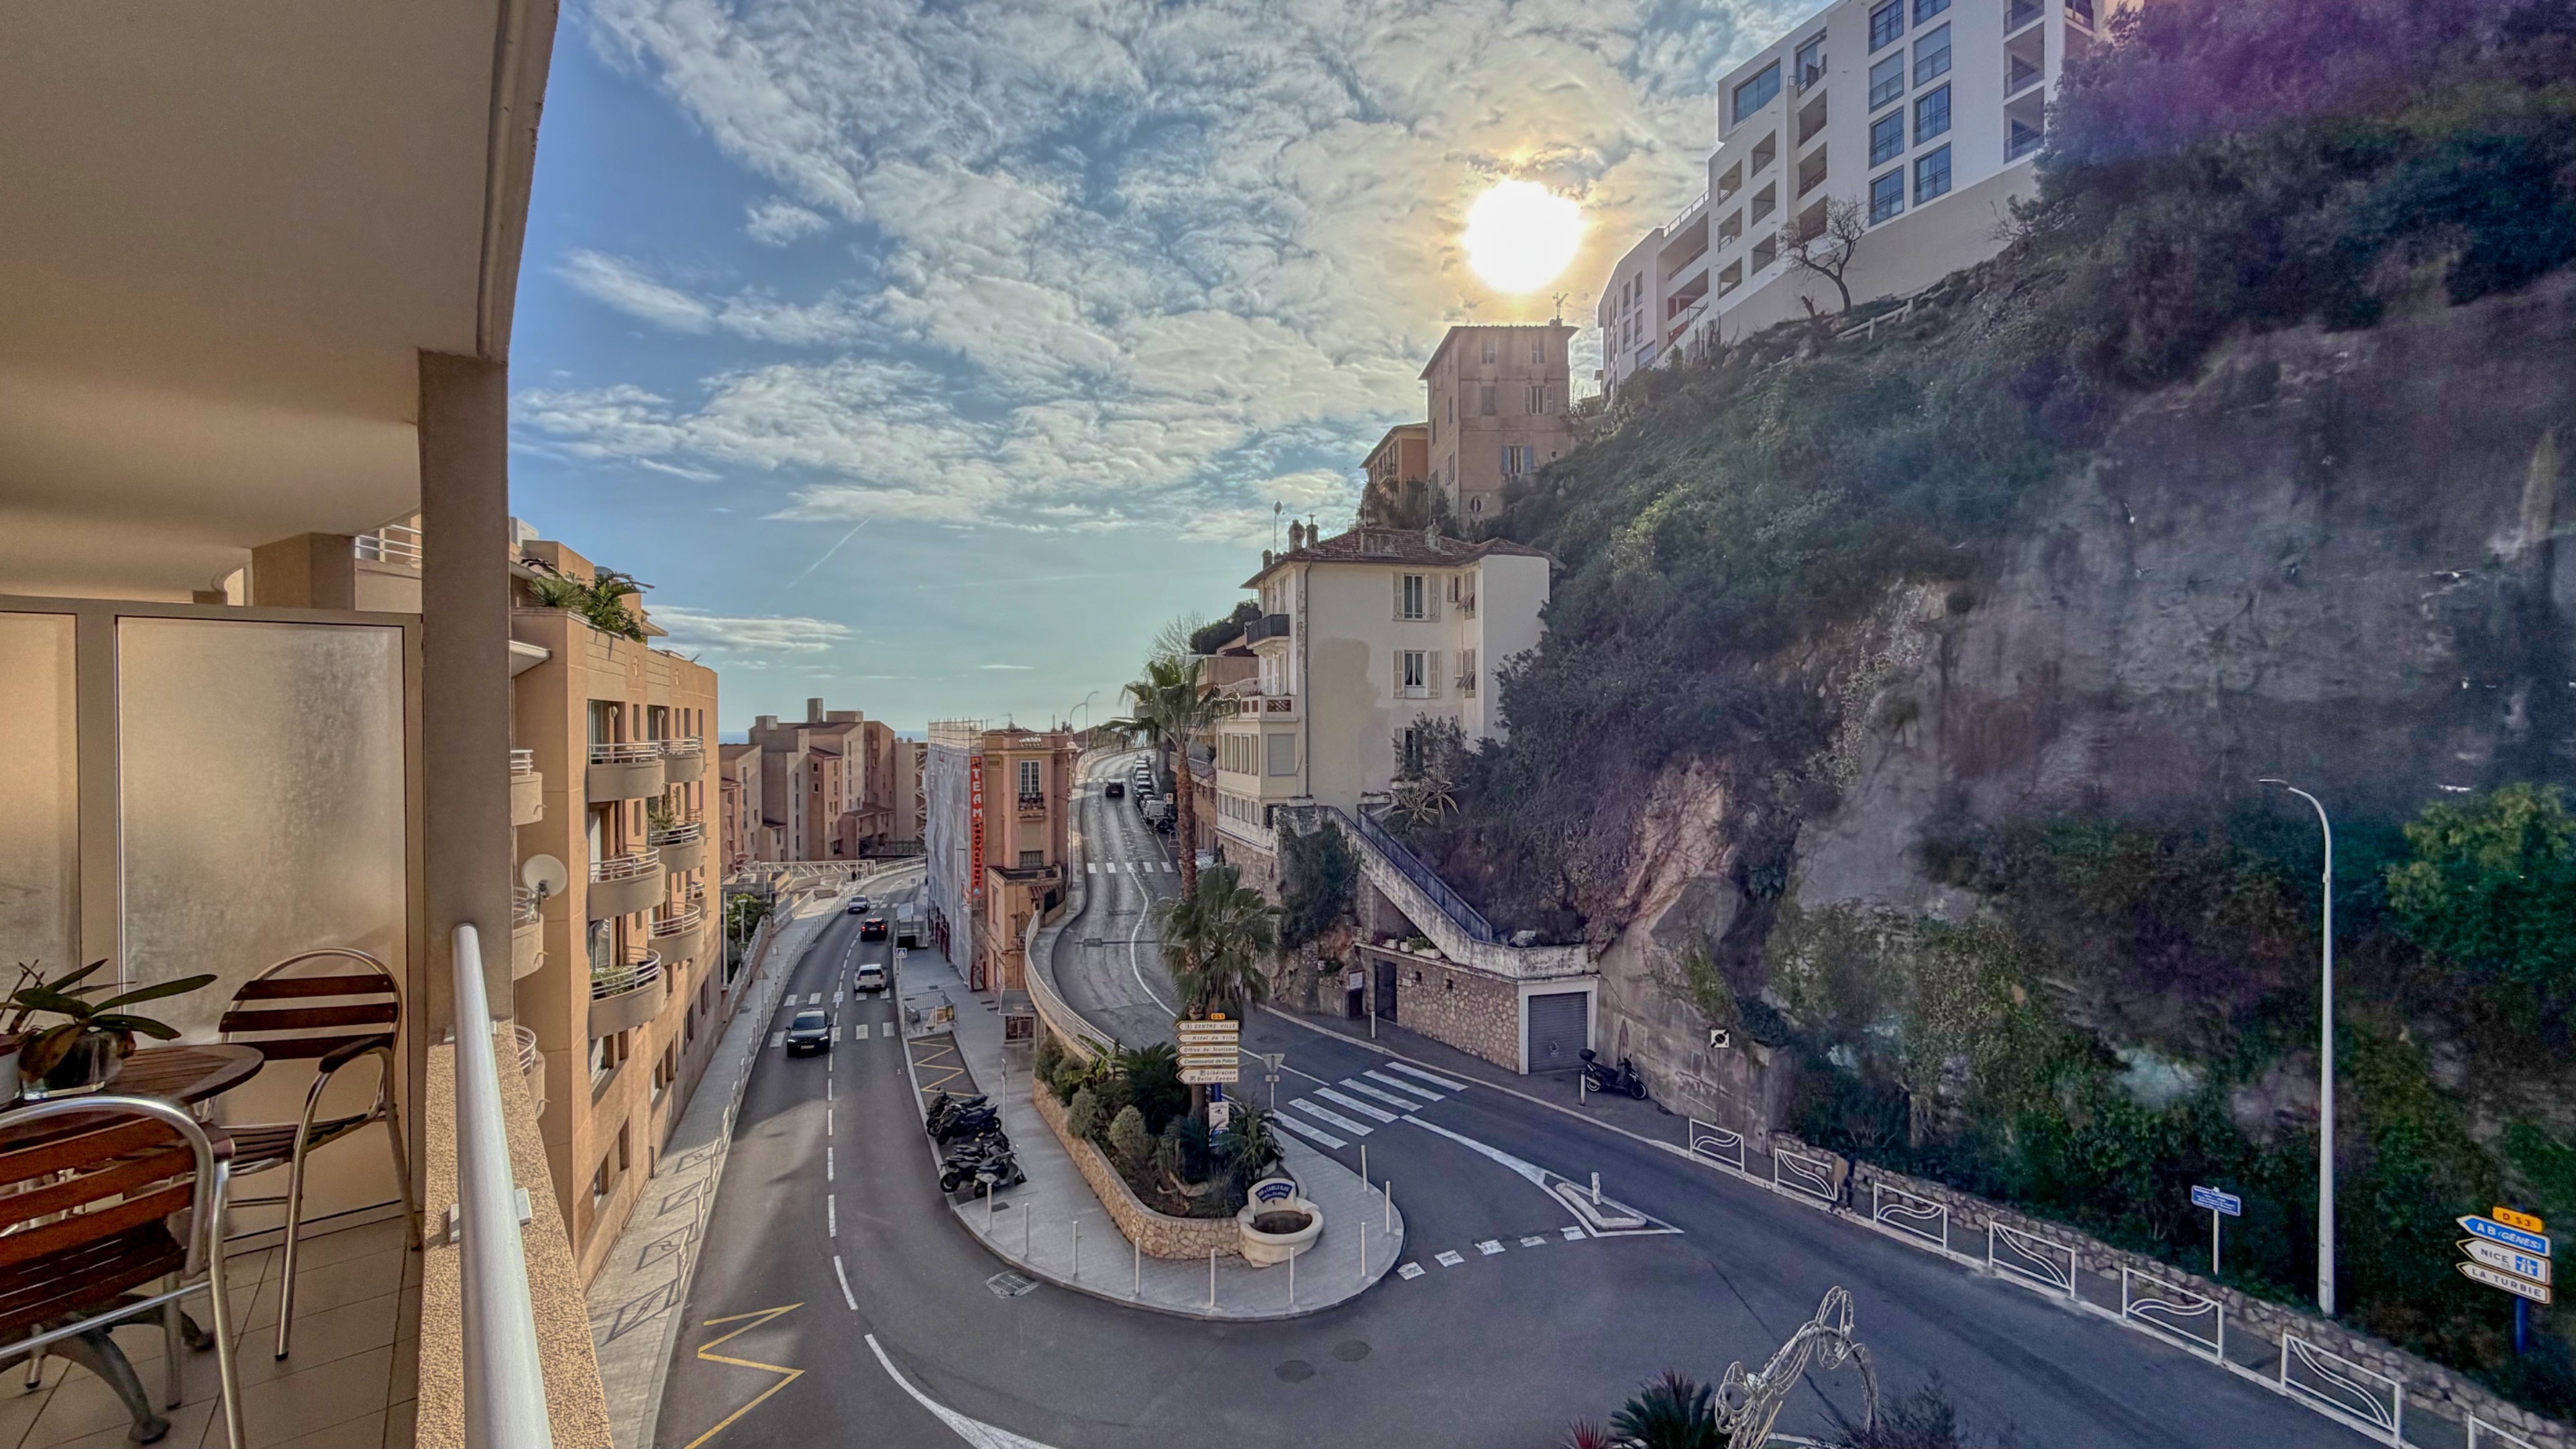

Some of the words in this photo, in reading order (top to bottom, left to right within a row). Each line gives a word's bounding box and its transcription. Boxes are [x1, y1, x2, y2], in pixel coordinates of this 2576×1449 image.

[972, 768, 983, 818] TEAM
[2481, 1248, 2509, 1264] NICE
[2472, 1268, 2486, 1279] LA
[2494, 1275, 2541, 1297] TURBIE
